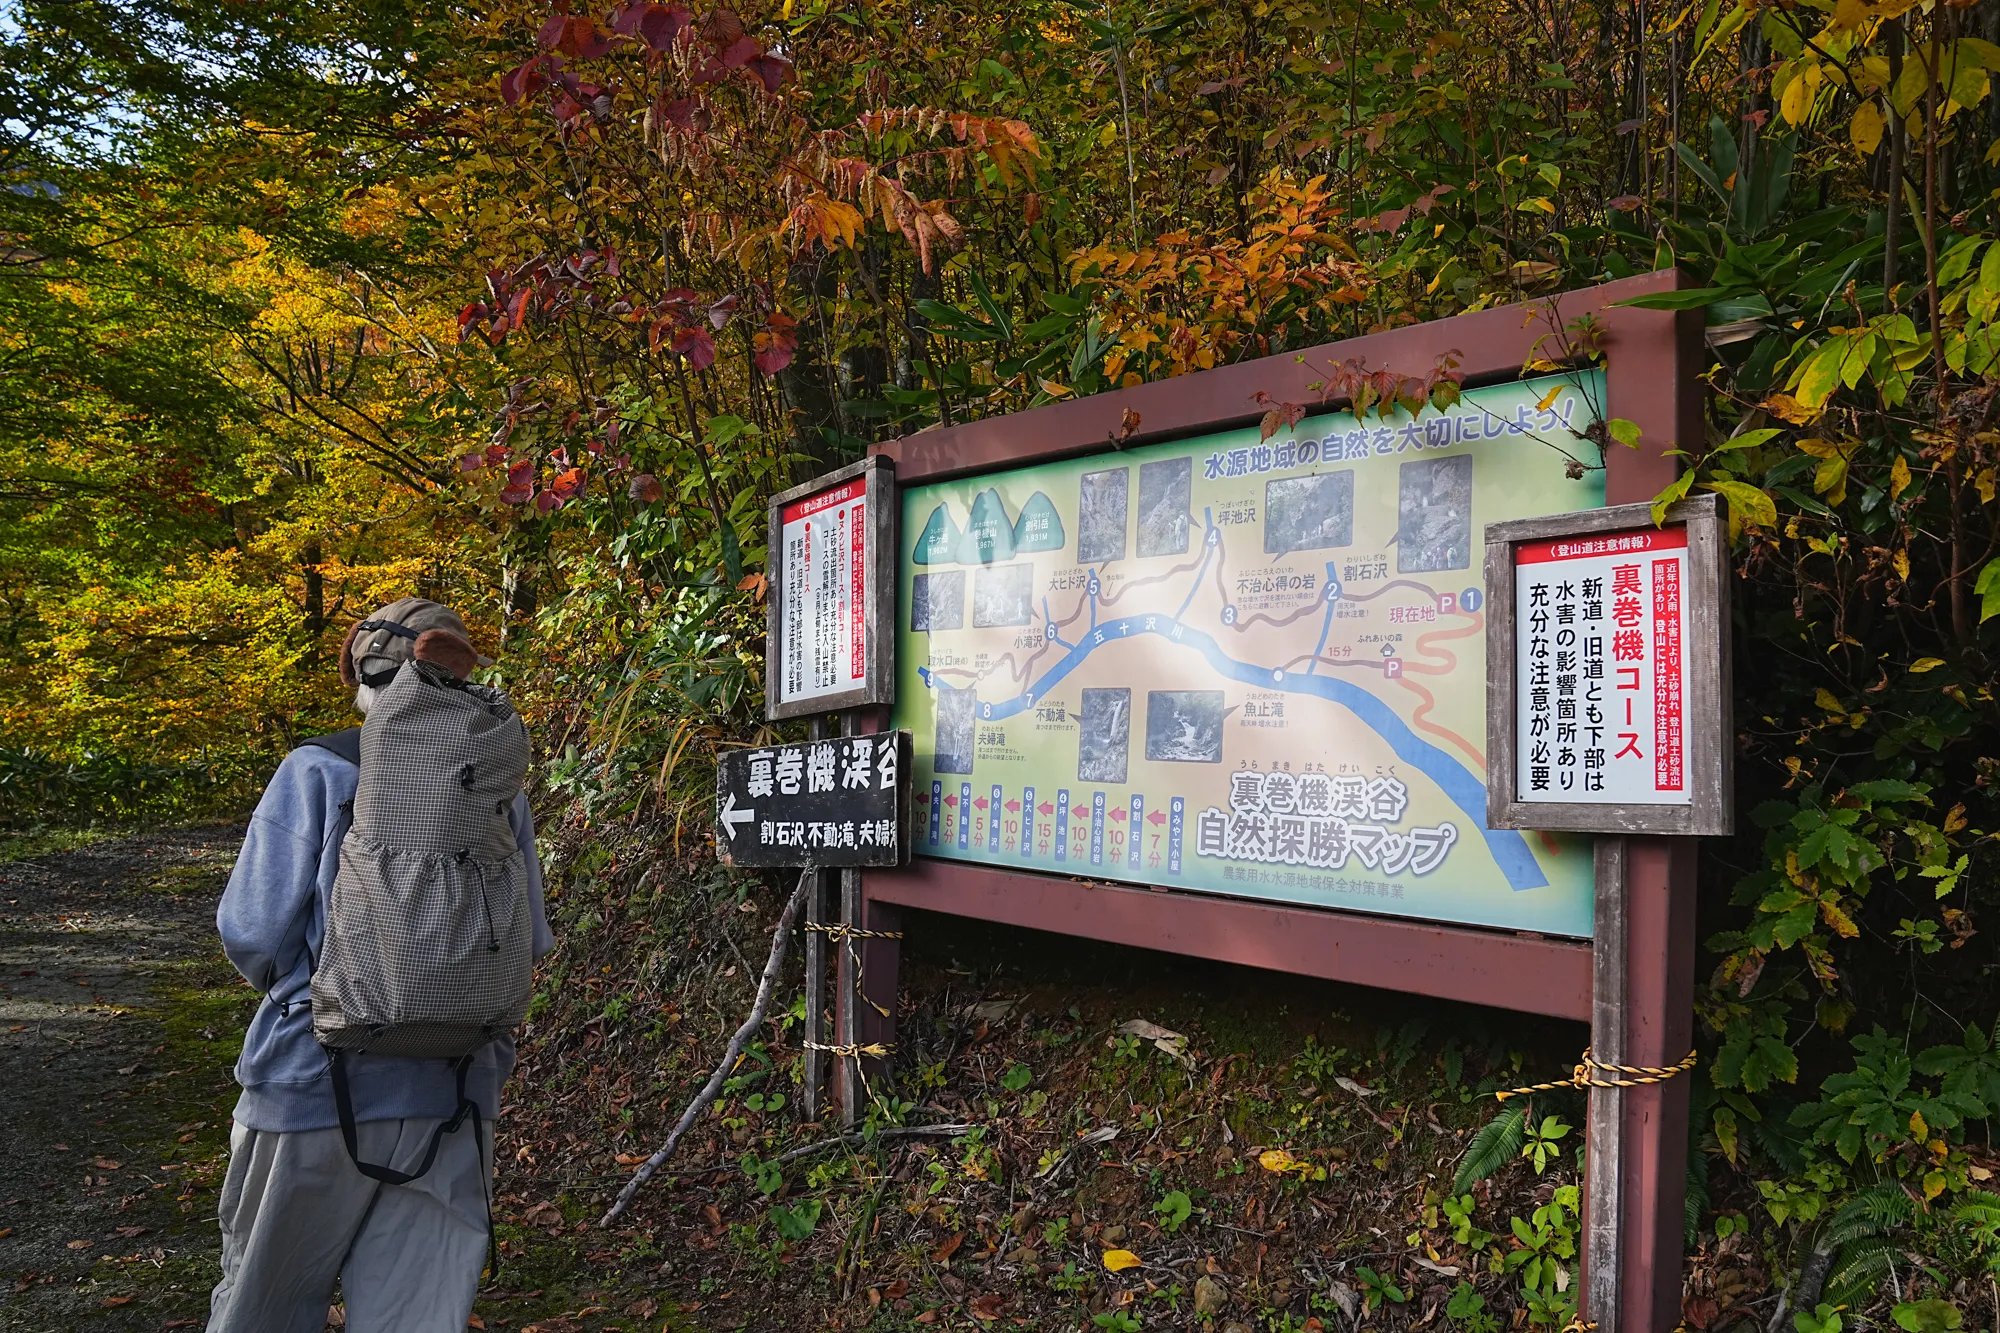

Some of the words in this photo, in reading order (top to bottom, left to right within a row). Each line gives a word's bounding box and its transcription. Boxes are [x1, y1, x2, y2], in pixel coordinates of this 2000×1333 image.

[1218, 508, 1256, 526] 坪池沢
[1026, 519, 1049, 532] 割引岳
[1208, 529, 1218, 545] 4
[1346, 554, 1387, 563] わりいしざわ
[1343, 562, 1388, 582] 割石沢
[1049, 576, 1086, 592] 大ヒド沢
[1089, 579, 1098, 595] 5
[1236, 573, 1316, 595] 不治心得の岩
[1327, 582, 1338, 600] 2
[1441, 596, 1453, 613] P
[1224, 607, 1234, 623] 3
[1389, 605, 1436, 624] 現在地
[1047, 624, 1056, 639] 6
[1357, 633, 1403, 644] ふれあいの森
[1013, 635, 1044, 649] 小滝沢
[1328, 646, 1353, 657] 15分
[1388, 661, 1399, 677] P
[1611, 563, 1645, 761] 裏巻機コース
[927, 672, 934, 687] 9
[1529, 582, 1551, 792] 充分な注意が必要
[1555, 579, 1577, 791] 水害の影響箇所あり
[1582, 577, 1605, 792] 新道・旧道とも下部は
[1026, 693, 1034, 708] 7
[983, 703, 991, 718] 8
[1035, 708, 1066, 723] 不動滝
[1243, 701, 1285, 718] 魚止滝
[977, 732, 1006, 746] 夫婦滝
[747, 736, 898, 799] 裏巻機渓谷
[1232, 773, 1404, 819] 裏巻機渓谷
[1199, 811, 1454, 873] 自然探勝マップ
[1222, 865, 1405, 900] 農業用水水源地域保全対策事業
